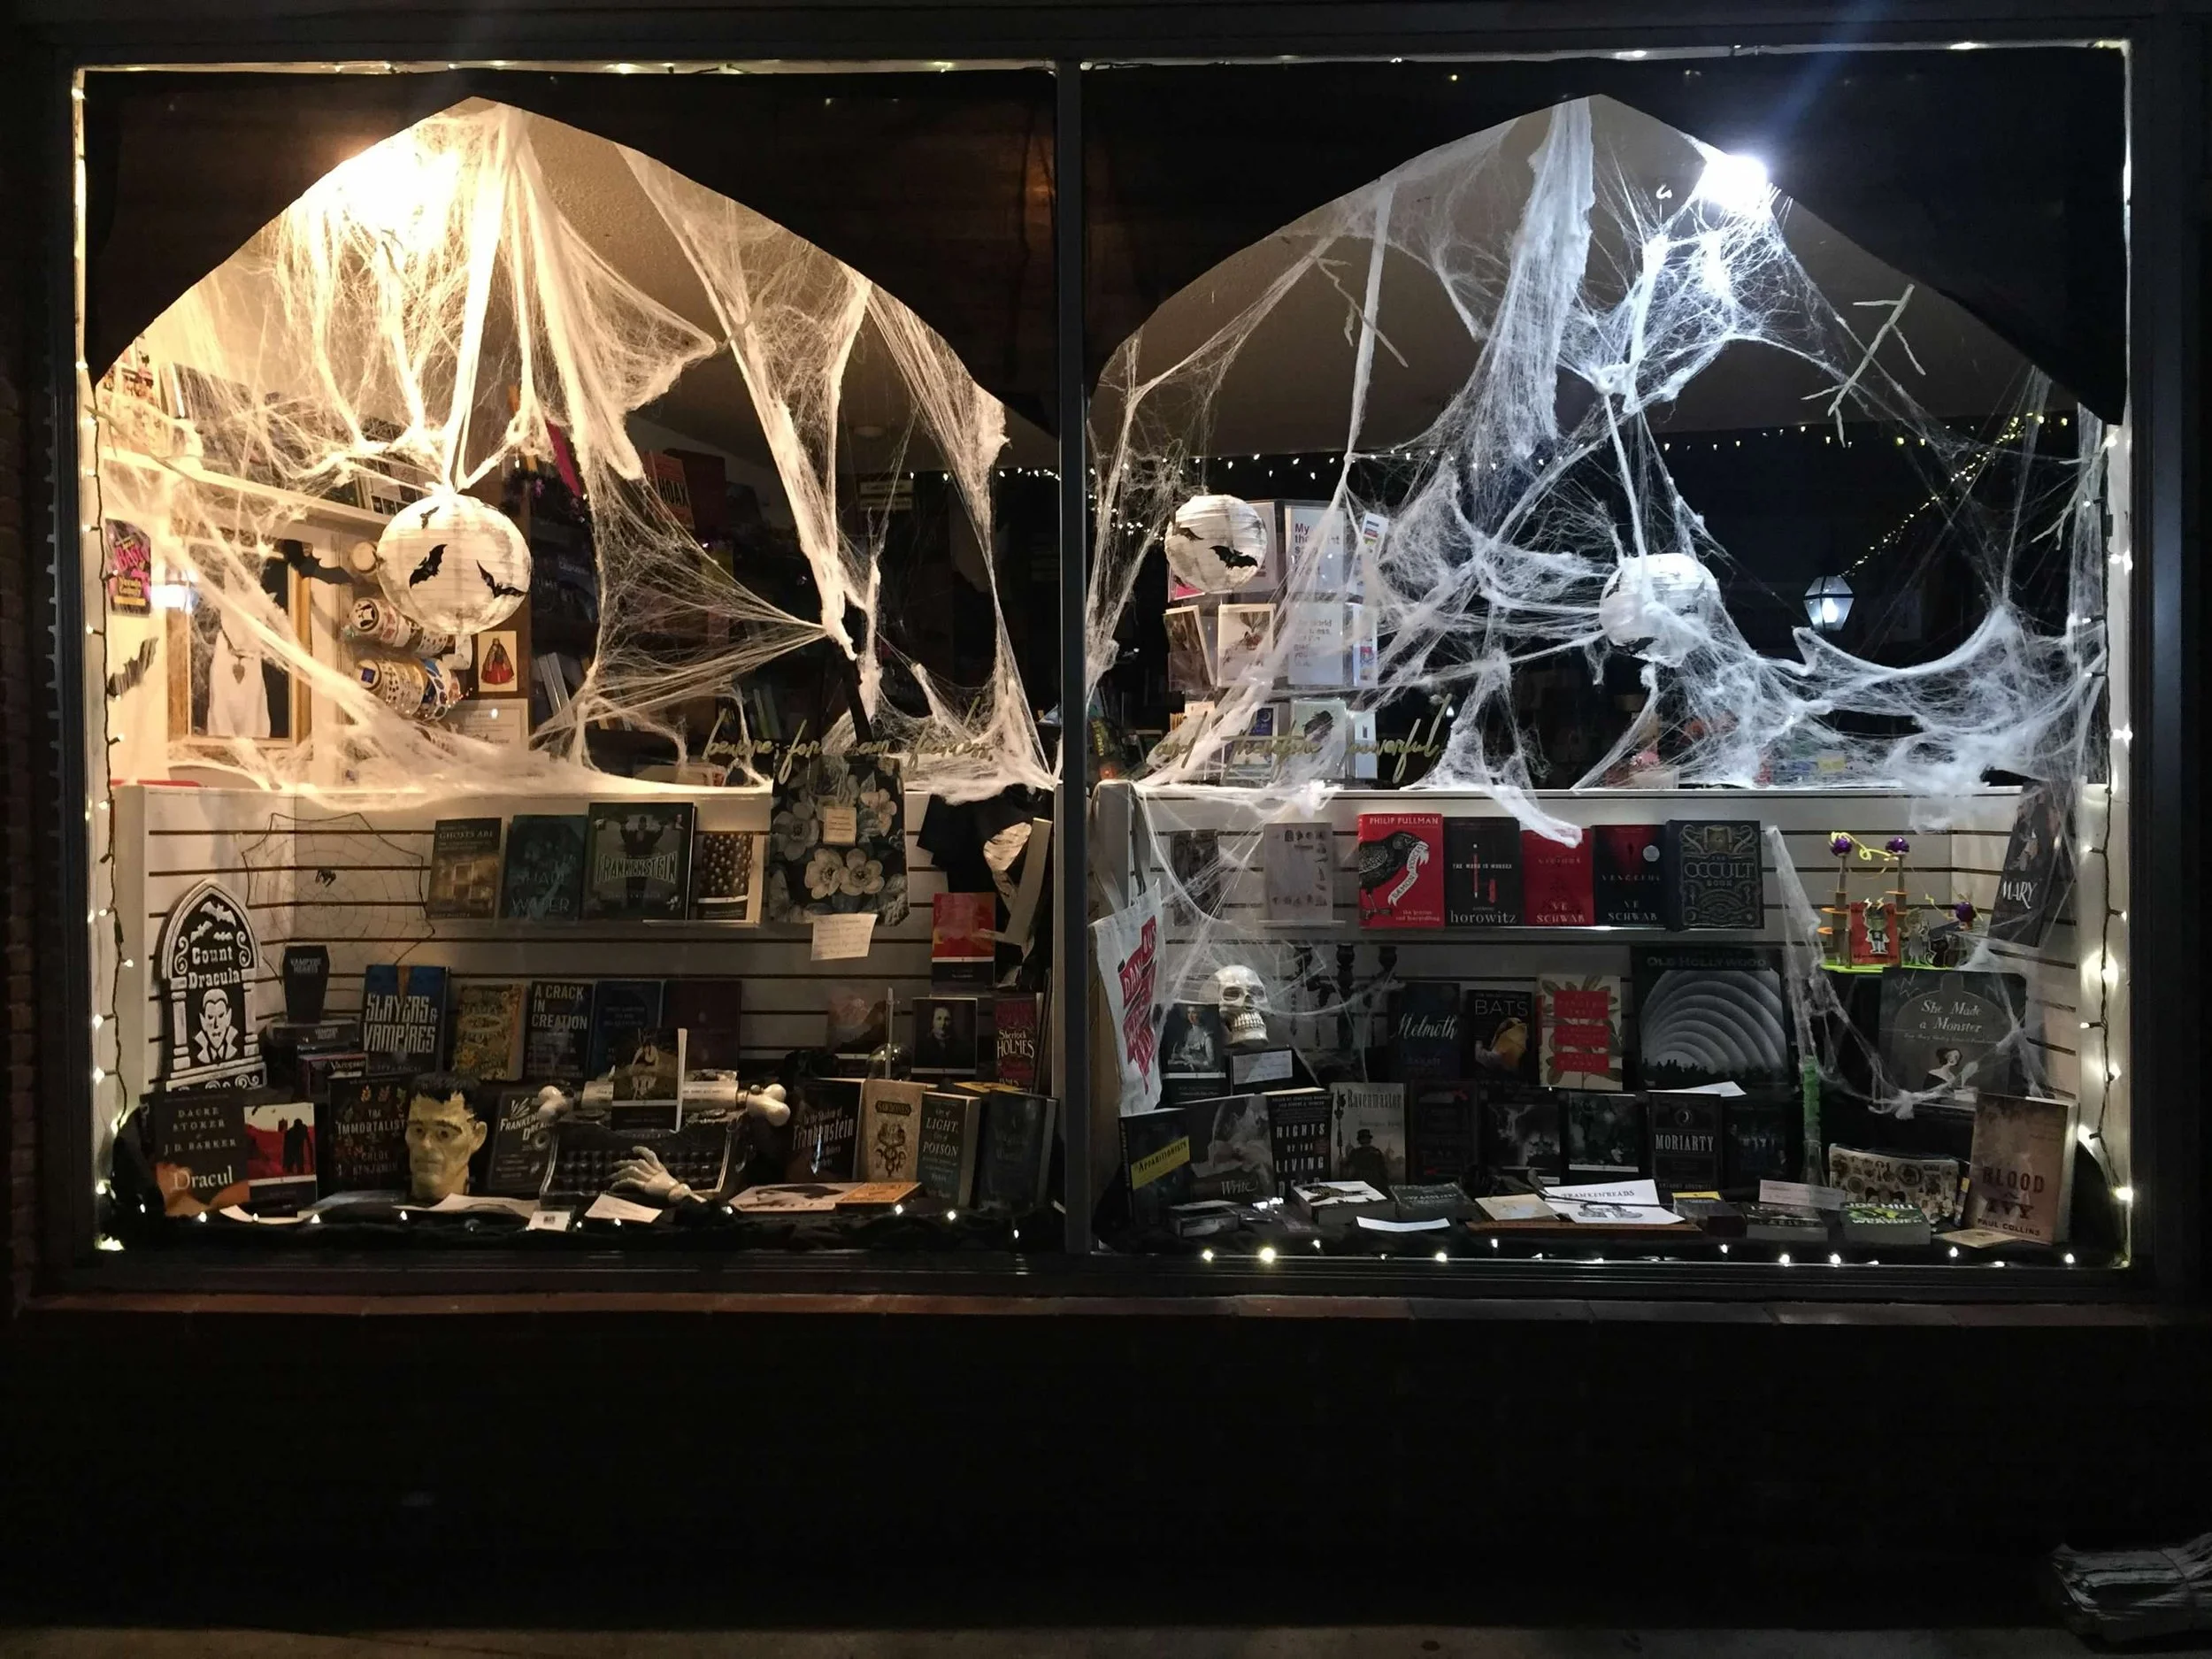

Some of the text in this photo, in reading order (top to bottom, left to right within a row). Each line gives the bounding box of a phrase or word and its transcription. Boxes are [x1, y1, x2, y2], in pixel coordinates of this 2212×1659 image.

[1294, 524, 1310, 534] My
[595, 852, 678, 885] FRANKENSTEIN
[1684, 862, 1753, 879] OCCULT
[1450, 910, 1517, 924] horowitz
[1536, 914, 1586, 924] SCHWAB
[1608, 912, 1657, 921] SCHWAB
[191, 948, 234, 965] Count
[188, 970, 241, 990] Dracula
[534, 984, 584, 1000] A CRACK
[365, 992, 430, 1022] SLAYERS
[533, 999, 545, 1013] IN
[1474, 999, 1529, 1017] BATS
[1921, 999, 1981, 1017] She Made
[532, 1014, 588, 1030] CREATION
[1397, 1013, 1458, 1040] Melmoth
[1919, 1017, 1982, 1033] a Monster
[363, 1022, 436, 1054] VAMPIRES
[998, 1029, 1026, 1041] Sherlock
[996, 1040, 1035, 1060] HOLMES
[1347, 1088, 1402, 1108] Ravenmaster
[178, 1106, 220, 1118] DACRE
[173, 1118, 226, 1133] STOKER
[1276, 1123, 1325, 1139] NIGHTS
[188, 1139, 237, 1152] BARKER
[923, 1141, 958, 1158] POISON
[1655, 1133, 1714, 1152] MORIARTY
[1276, 1156, 1324, 1173] LIVING
[174, 1165, 234, 1192] Dracul
[1983, 1165, 2045, 1194] BLOOD
[1986, 1198, 2033, 1218] IVY
[1977, 1217, 2040, 1236] PAUL COLLINS
